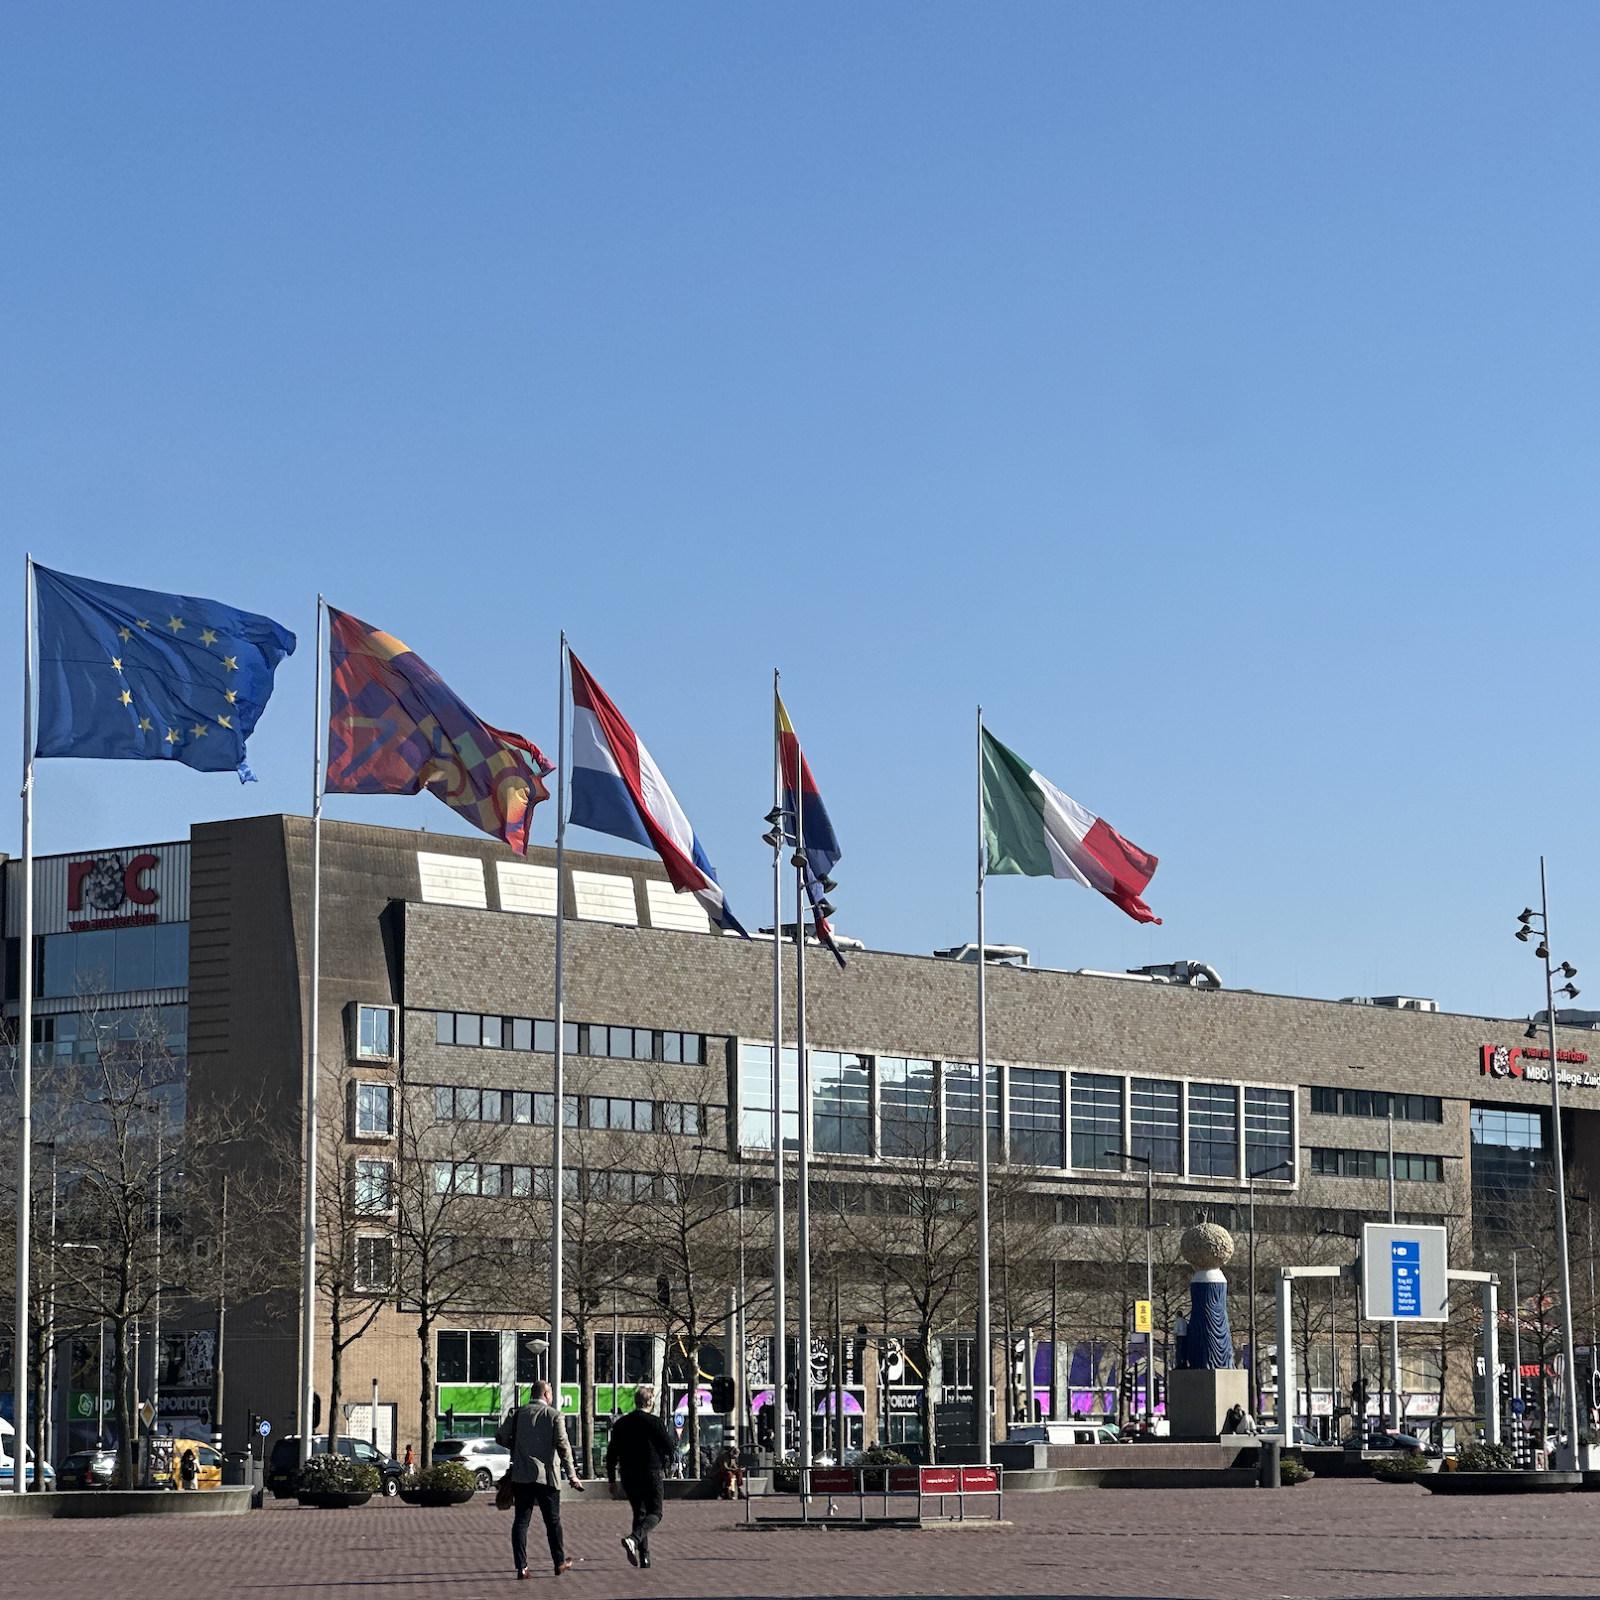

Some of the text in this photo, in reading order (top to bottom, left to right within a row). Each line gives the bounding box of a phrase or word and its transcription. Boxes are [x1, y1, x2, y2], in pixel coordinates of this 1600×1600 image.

[1526, 1047, 1589, 1062] van asterdam
[1527, 1066, 1548, 1080] MBO
